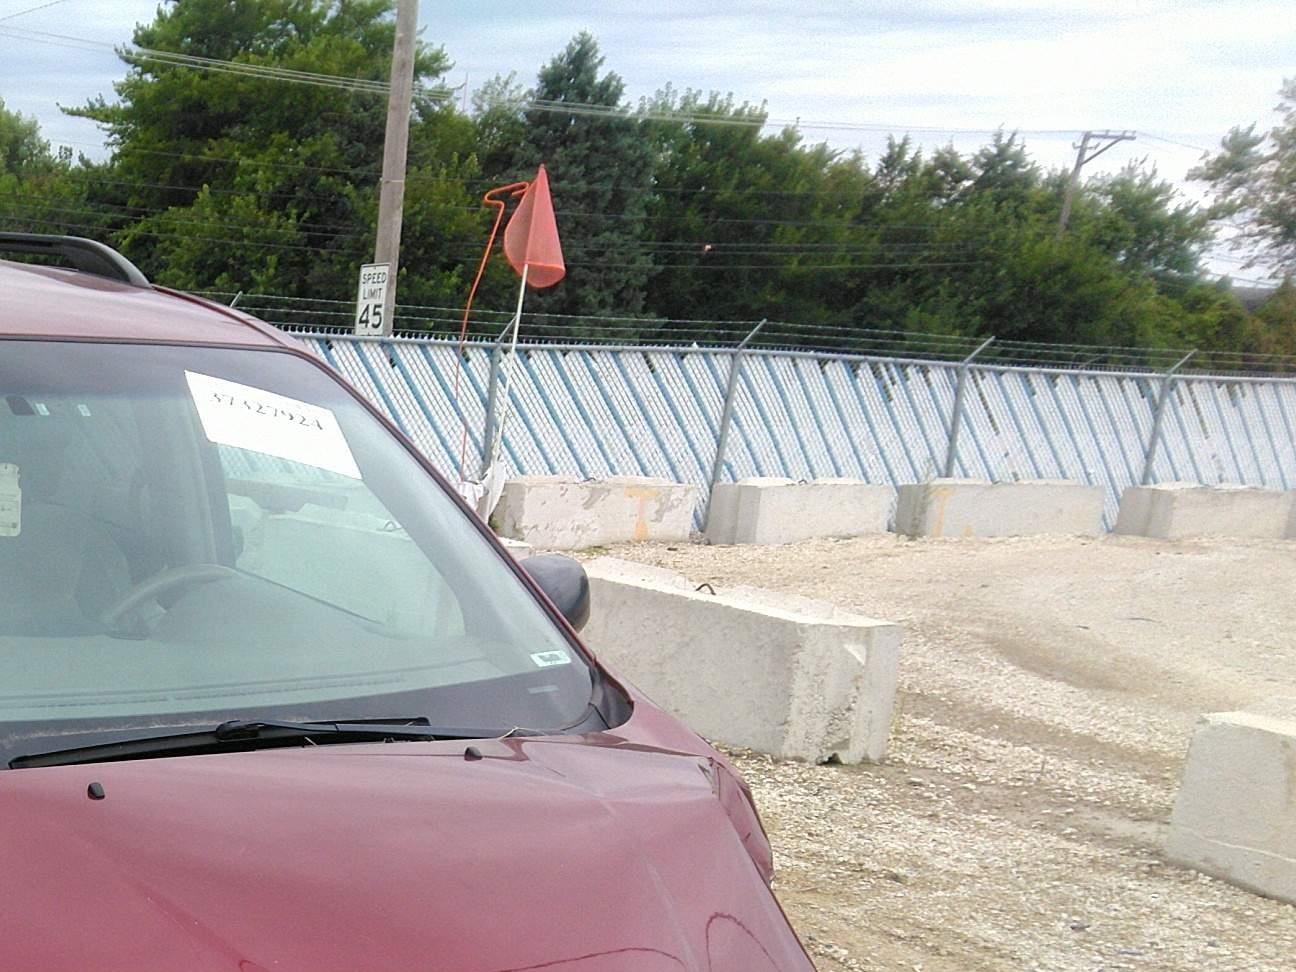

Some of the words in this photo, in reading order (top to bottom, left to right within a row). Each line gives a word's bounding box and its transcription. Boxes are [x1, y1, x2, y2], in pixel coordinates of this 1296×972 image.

[362, 271, 387, 284] SPEED
[362, 287, 383, 300] LIMIT
[359, 303, 383, 329] 45
